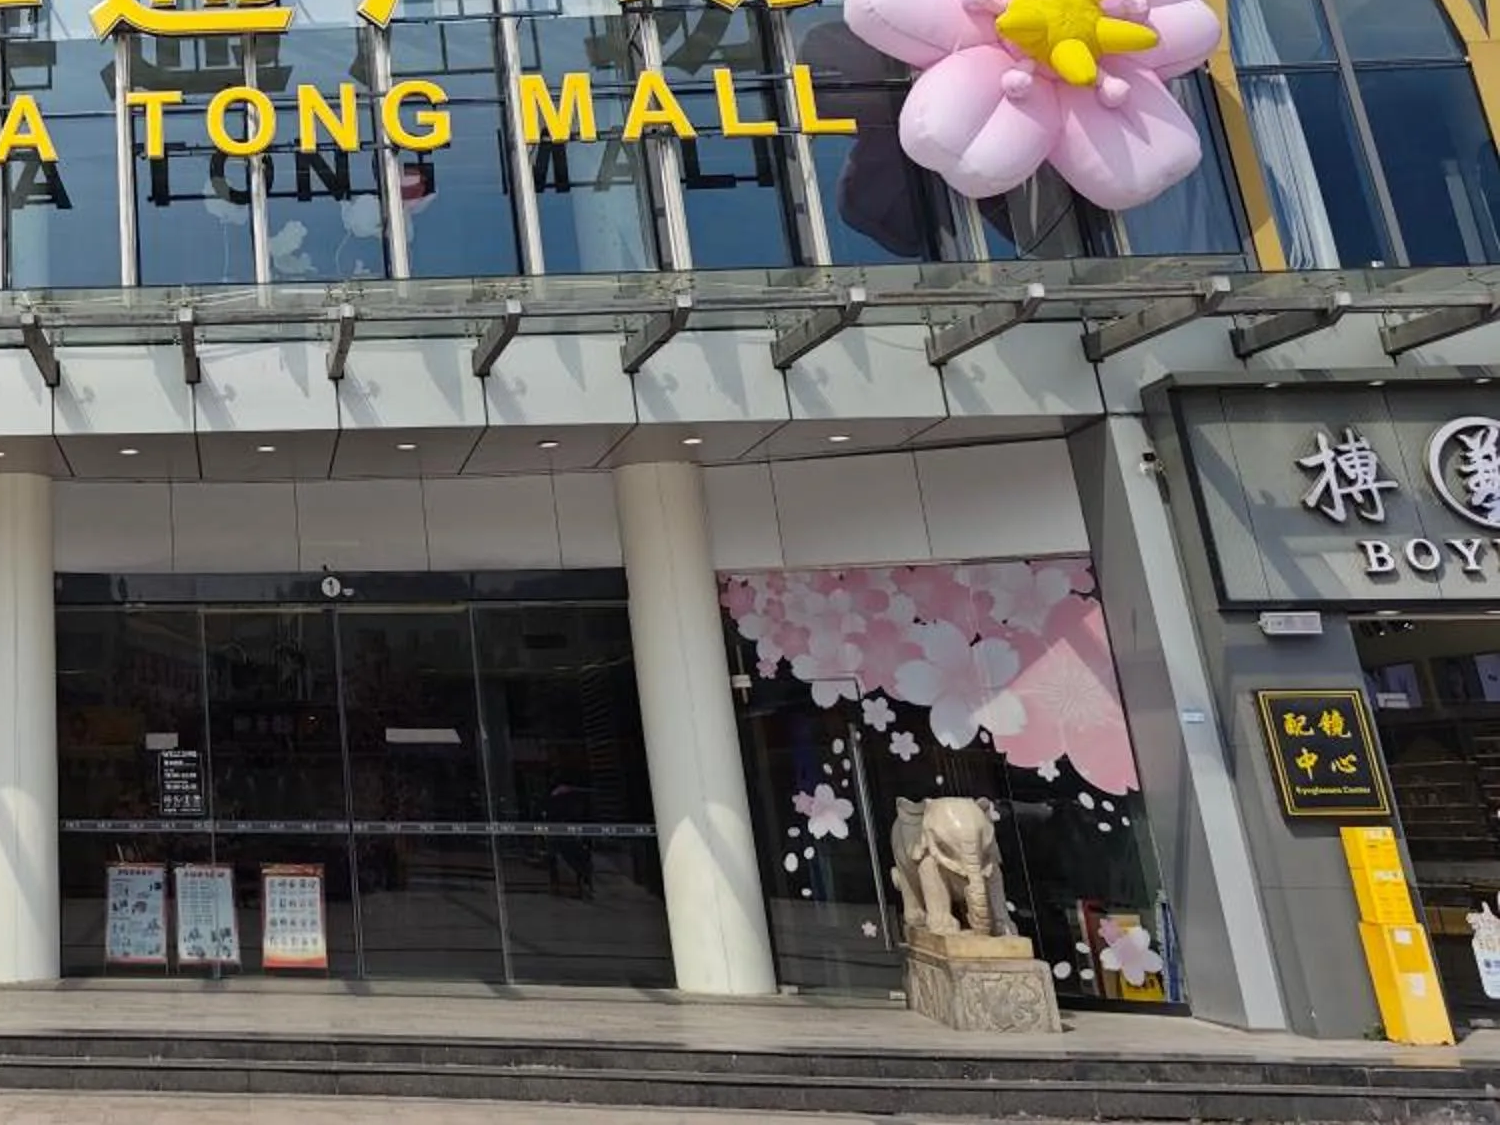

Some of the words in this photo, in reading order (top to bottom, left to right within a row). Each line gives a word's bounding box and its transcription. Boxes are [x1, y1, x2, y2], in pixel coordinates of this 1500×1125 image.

[126, 80, 453, 160] TONG
[519, 64, 858, 143] MALL
[1283, 708, 1353, 738] 配镜
[1295, 746, 1359, 781] 中心
